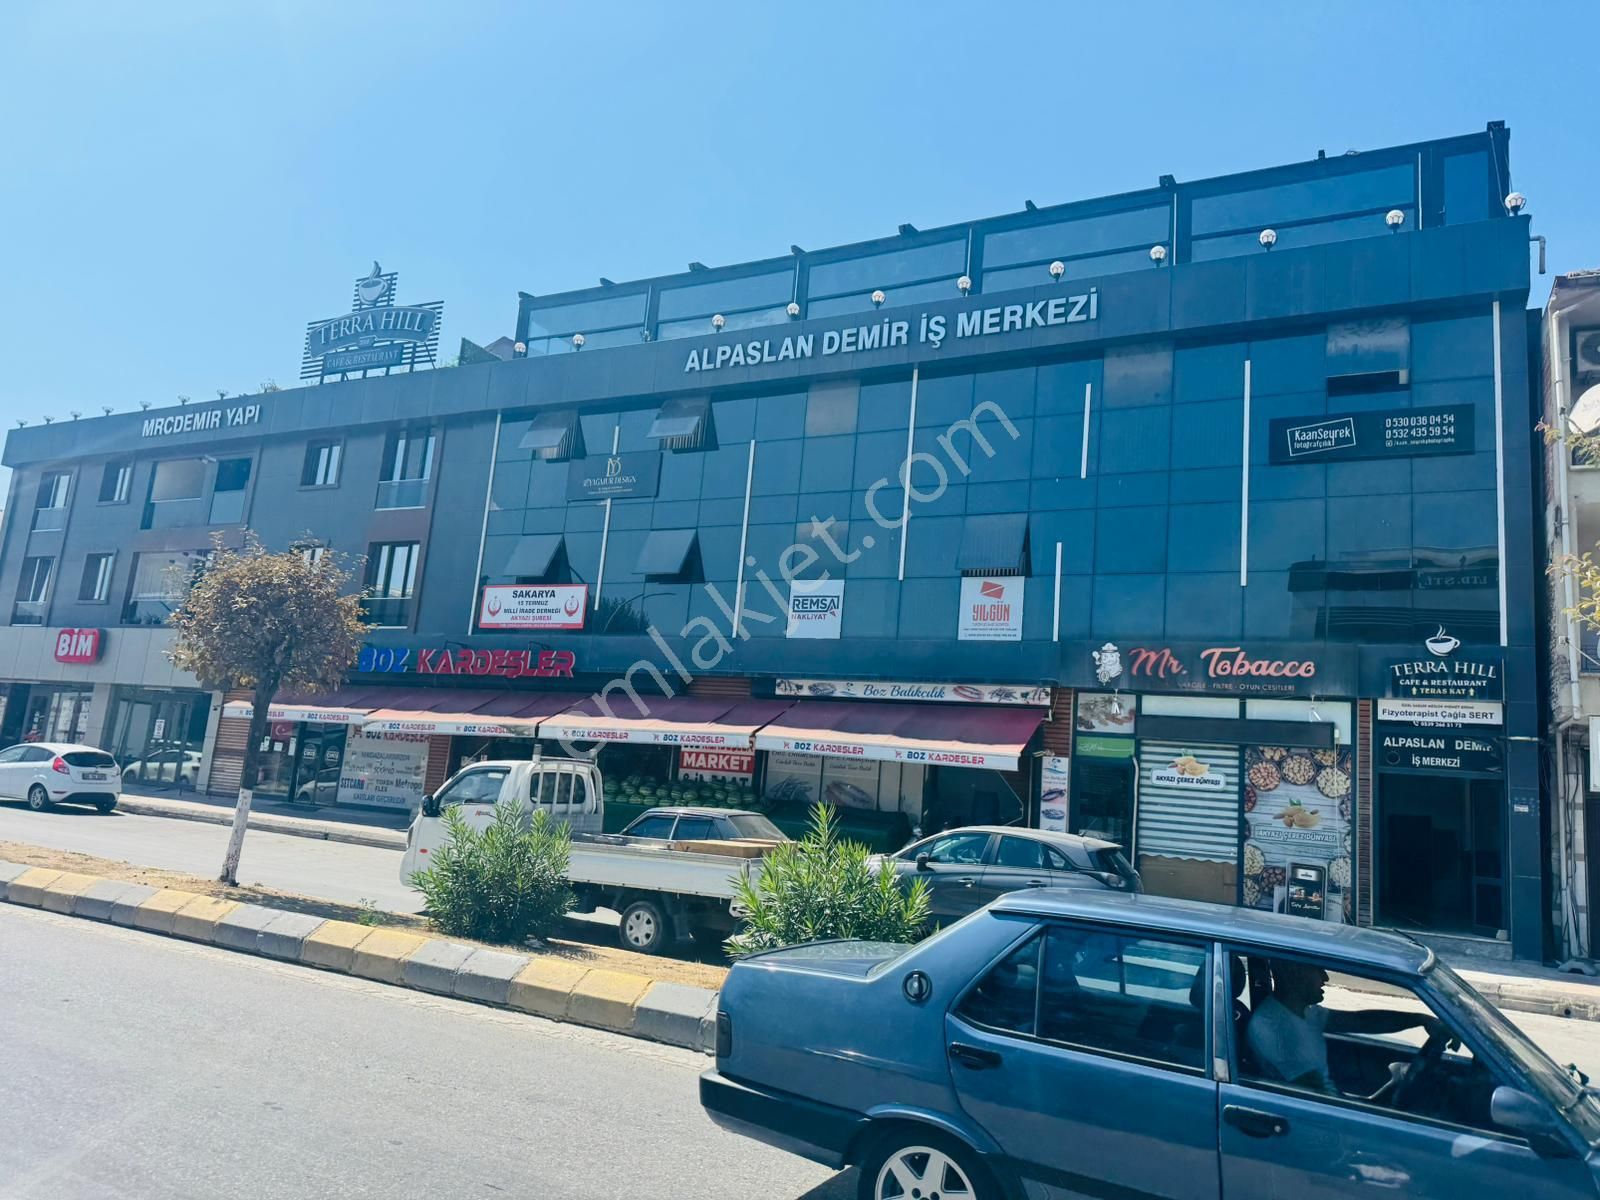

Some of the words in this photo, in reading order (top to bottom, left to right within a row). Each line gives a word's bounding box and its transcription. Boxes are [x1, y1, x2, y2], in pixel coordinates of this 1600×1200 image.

[319, 313, 374, 345] TERRA
[380, 311, 424, 332] HILL
[684, 334, 813, 372] ALPASLAN
[822, 318, 909, 355] DEMİR
[919, 313, 946, 348] İŞ
[956, 287, 1098, 338] MERKEZİ
[142, 408, 222, 437] MRCDEMİR
[226, 405, 260, 427] YAPI
[1295, 426, 1351, 446] KaanSeyrek
[512, 590, 556, 599] SAKARYA
[792, 598, 837, 610] REMSA
[973, 601, 1011, 622] YILGÜN
[57, 628, 93, 657] BİM
[359, 649, 410, 673] BOZ
[416, 648, 575, 679] KARDEŞLER
[1129, 648, 1188, 679] Mr.
[1200, 646, 1315, 677] Tobacco
[1390, 661, 1448, 677] TERRA
[1455, 661, 1497, 679] HILL
[863, 684, 888, 697] Boz
[1382, 708, 1438, 718] Fizyoterapist
[1441, 710, 1466, 720] Çağla
[1469, 711, 1494, 720] SERT
[663, 734, 678, 742] BOZ
[794, 742, 811, 750] BOZ
[1384, 736, 1445, 750] ALPASLAN
[682, 752, 752, 771] MARKET
[907, 751, 925, 760] BOZ
[1412, 753, 1421, 767] İŞ
[1422, 755, 1460, 768] MERKEZİ
